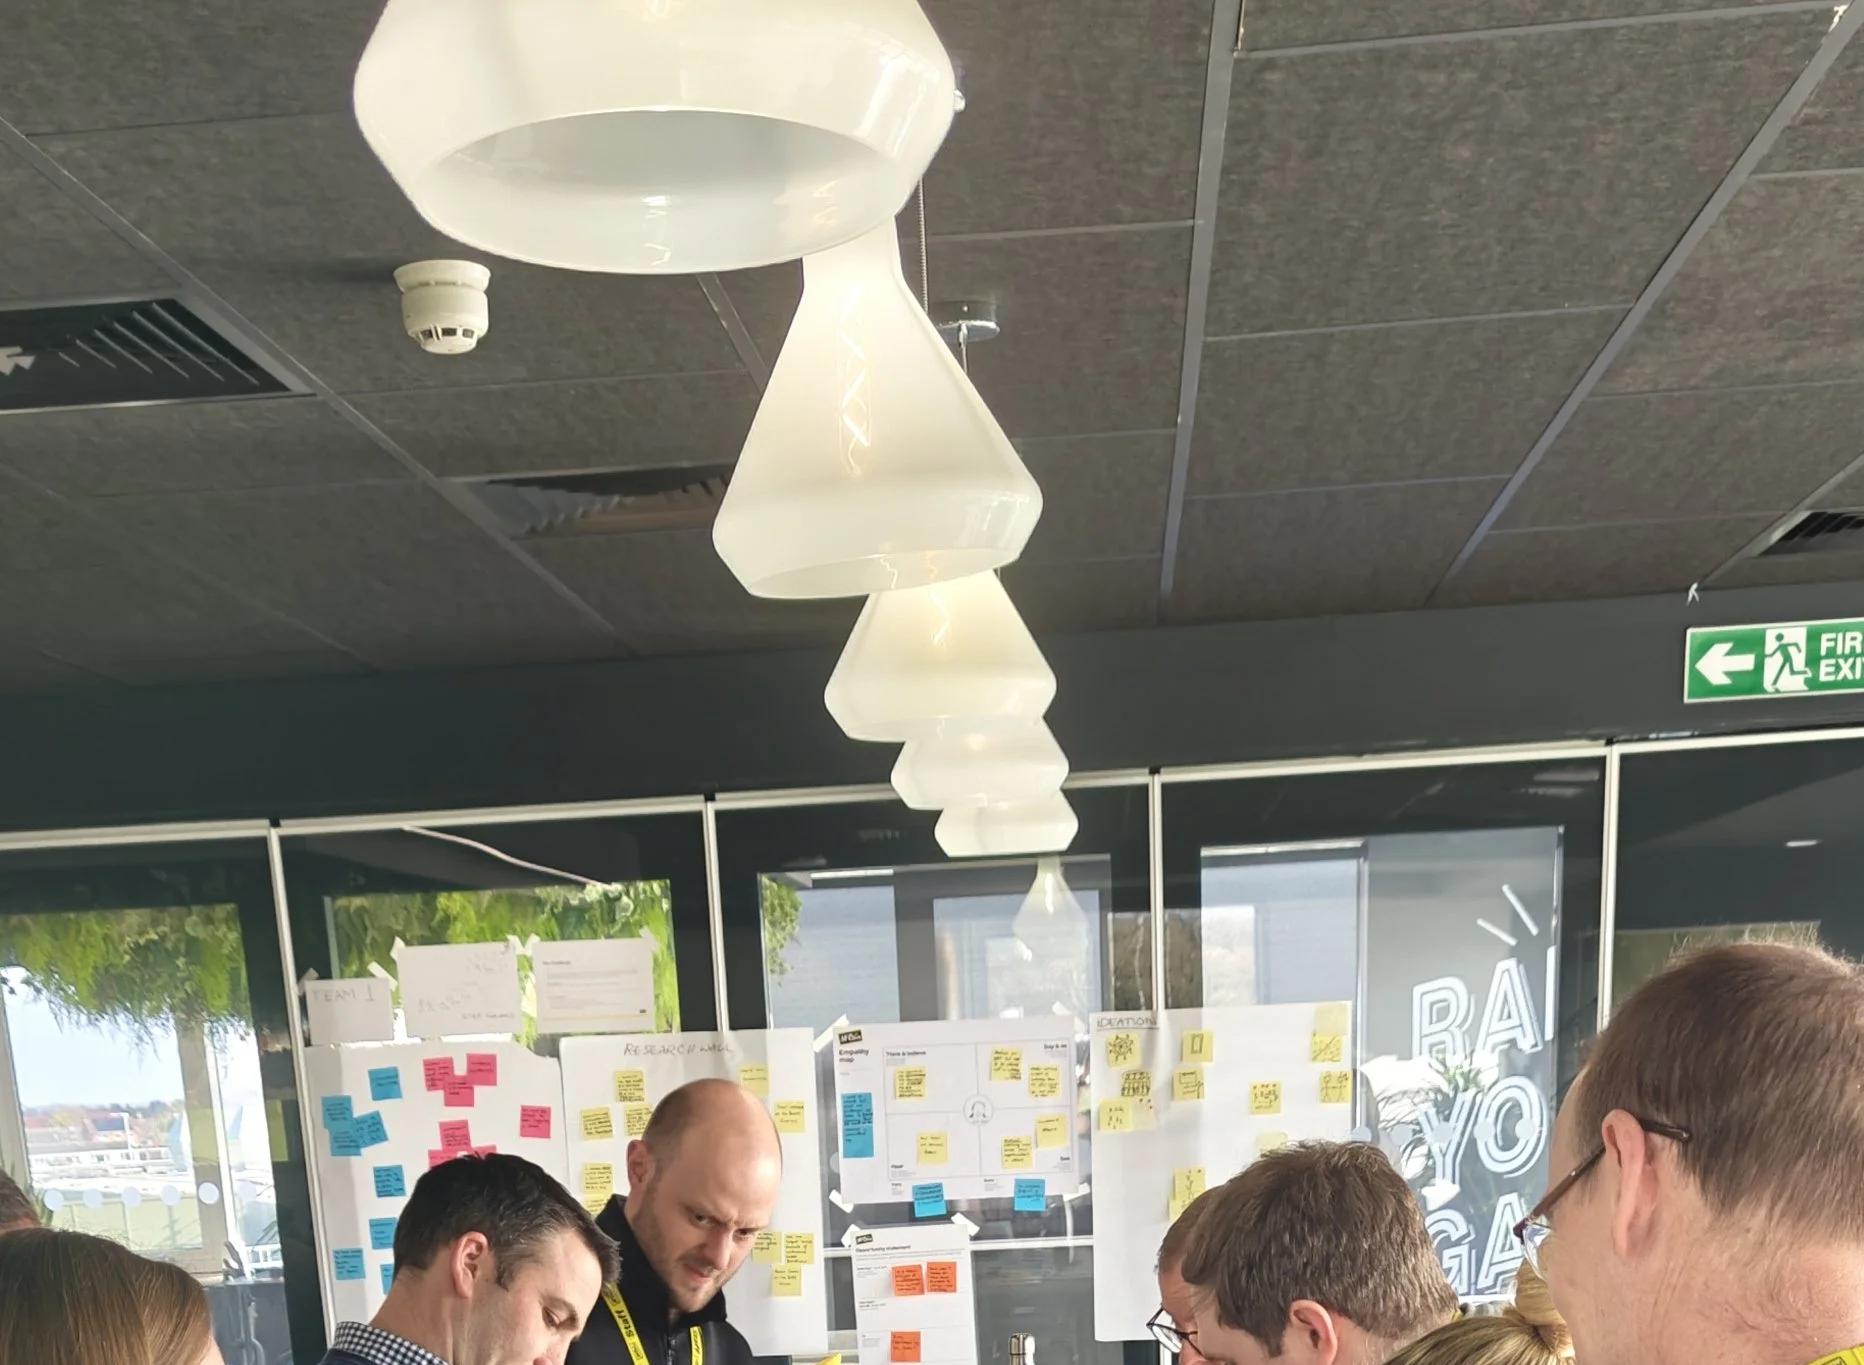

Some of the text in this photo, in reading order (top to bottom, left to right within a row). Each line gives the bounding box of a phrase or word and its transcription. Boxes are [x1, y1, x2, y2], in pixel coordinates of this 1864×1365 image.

[1819, 631, 1864, 656] FIR
[312, 988, 356, 1002] TEAM
[1412, 944, 1557, 1062] RA
[1097, 1017, 1157, 1027] IDEATION
[624, 1043, 696, 1056] RESEARCH
[1418, 1075, 1548, 1187] YO
[1426, 1191, 1530, 1297] GA
[615, 1310, 634, 1337] Staff
